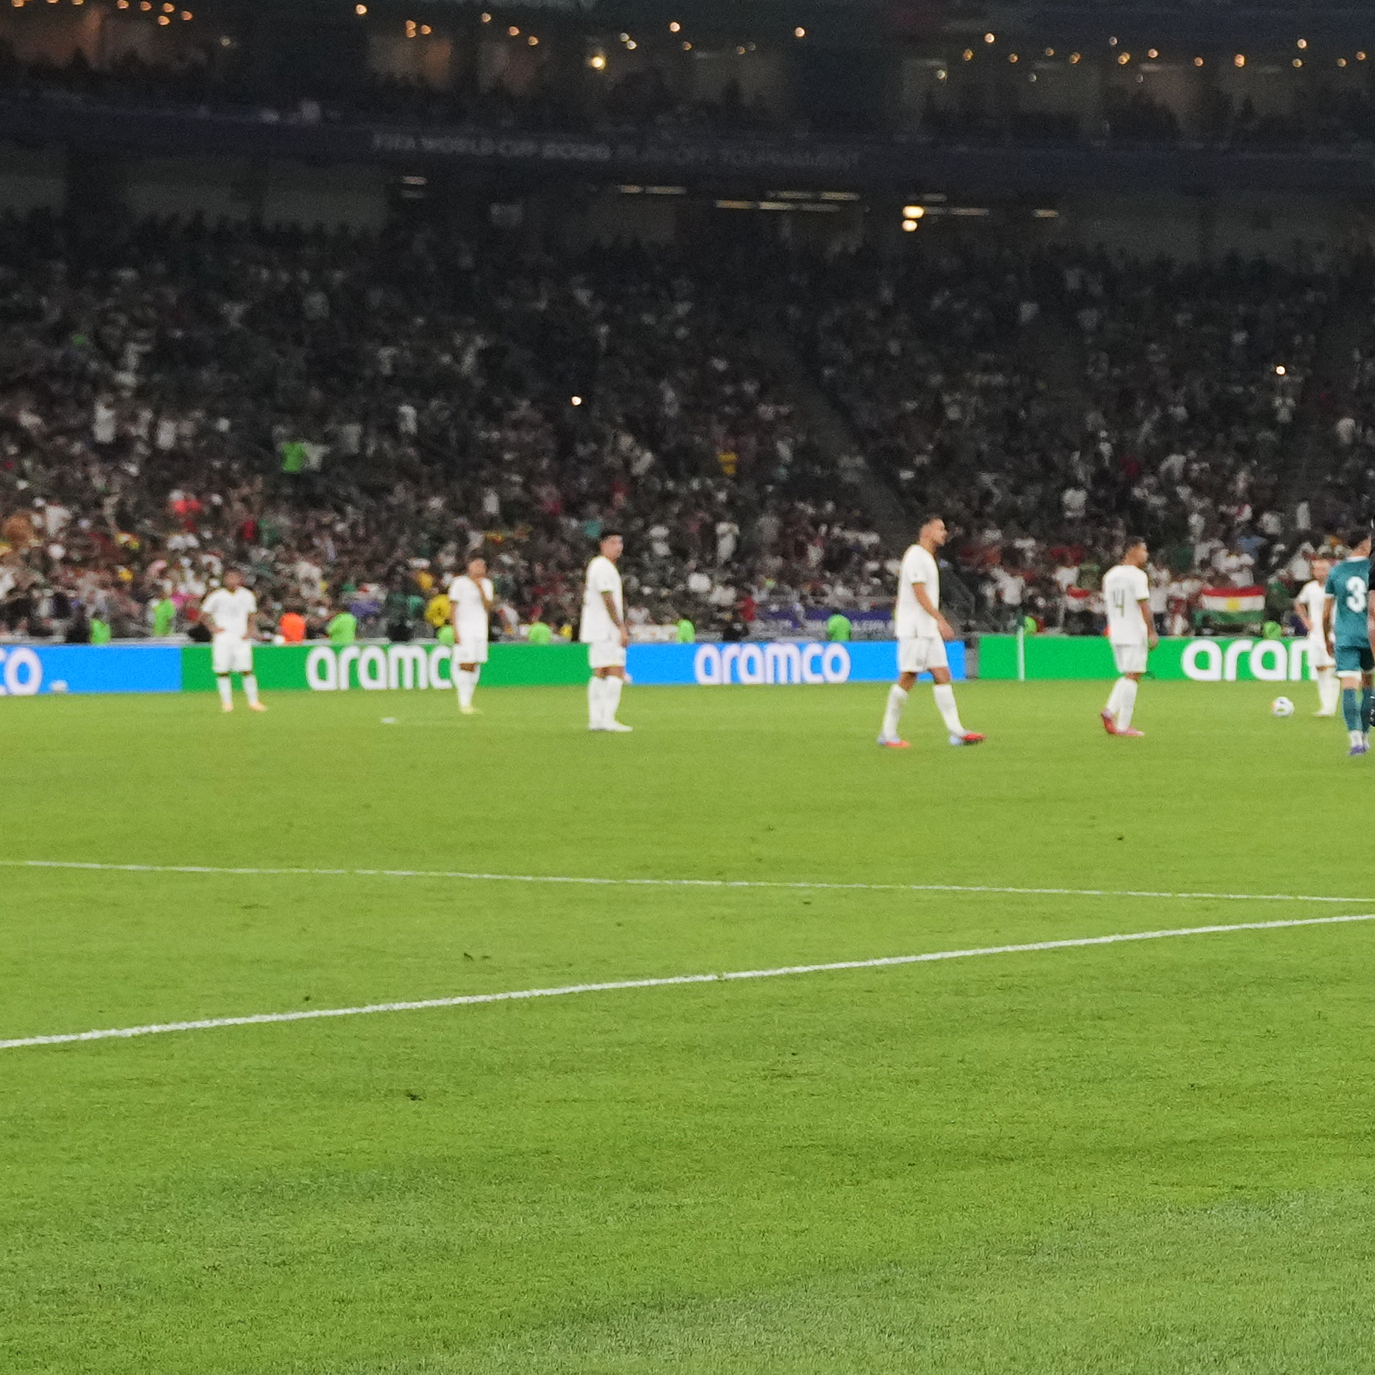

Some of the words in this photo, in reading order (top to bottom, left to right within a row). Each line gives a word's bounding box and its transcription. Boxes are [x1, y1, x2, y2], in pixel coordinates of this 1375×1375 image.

[1346, 576, 1367, 613] 3
[306, 645, 452, 691] aramc
[694, 643, 851, 685] aramco
